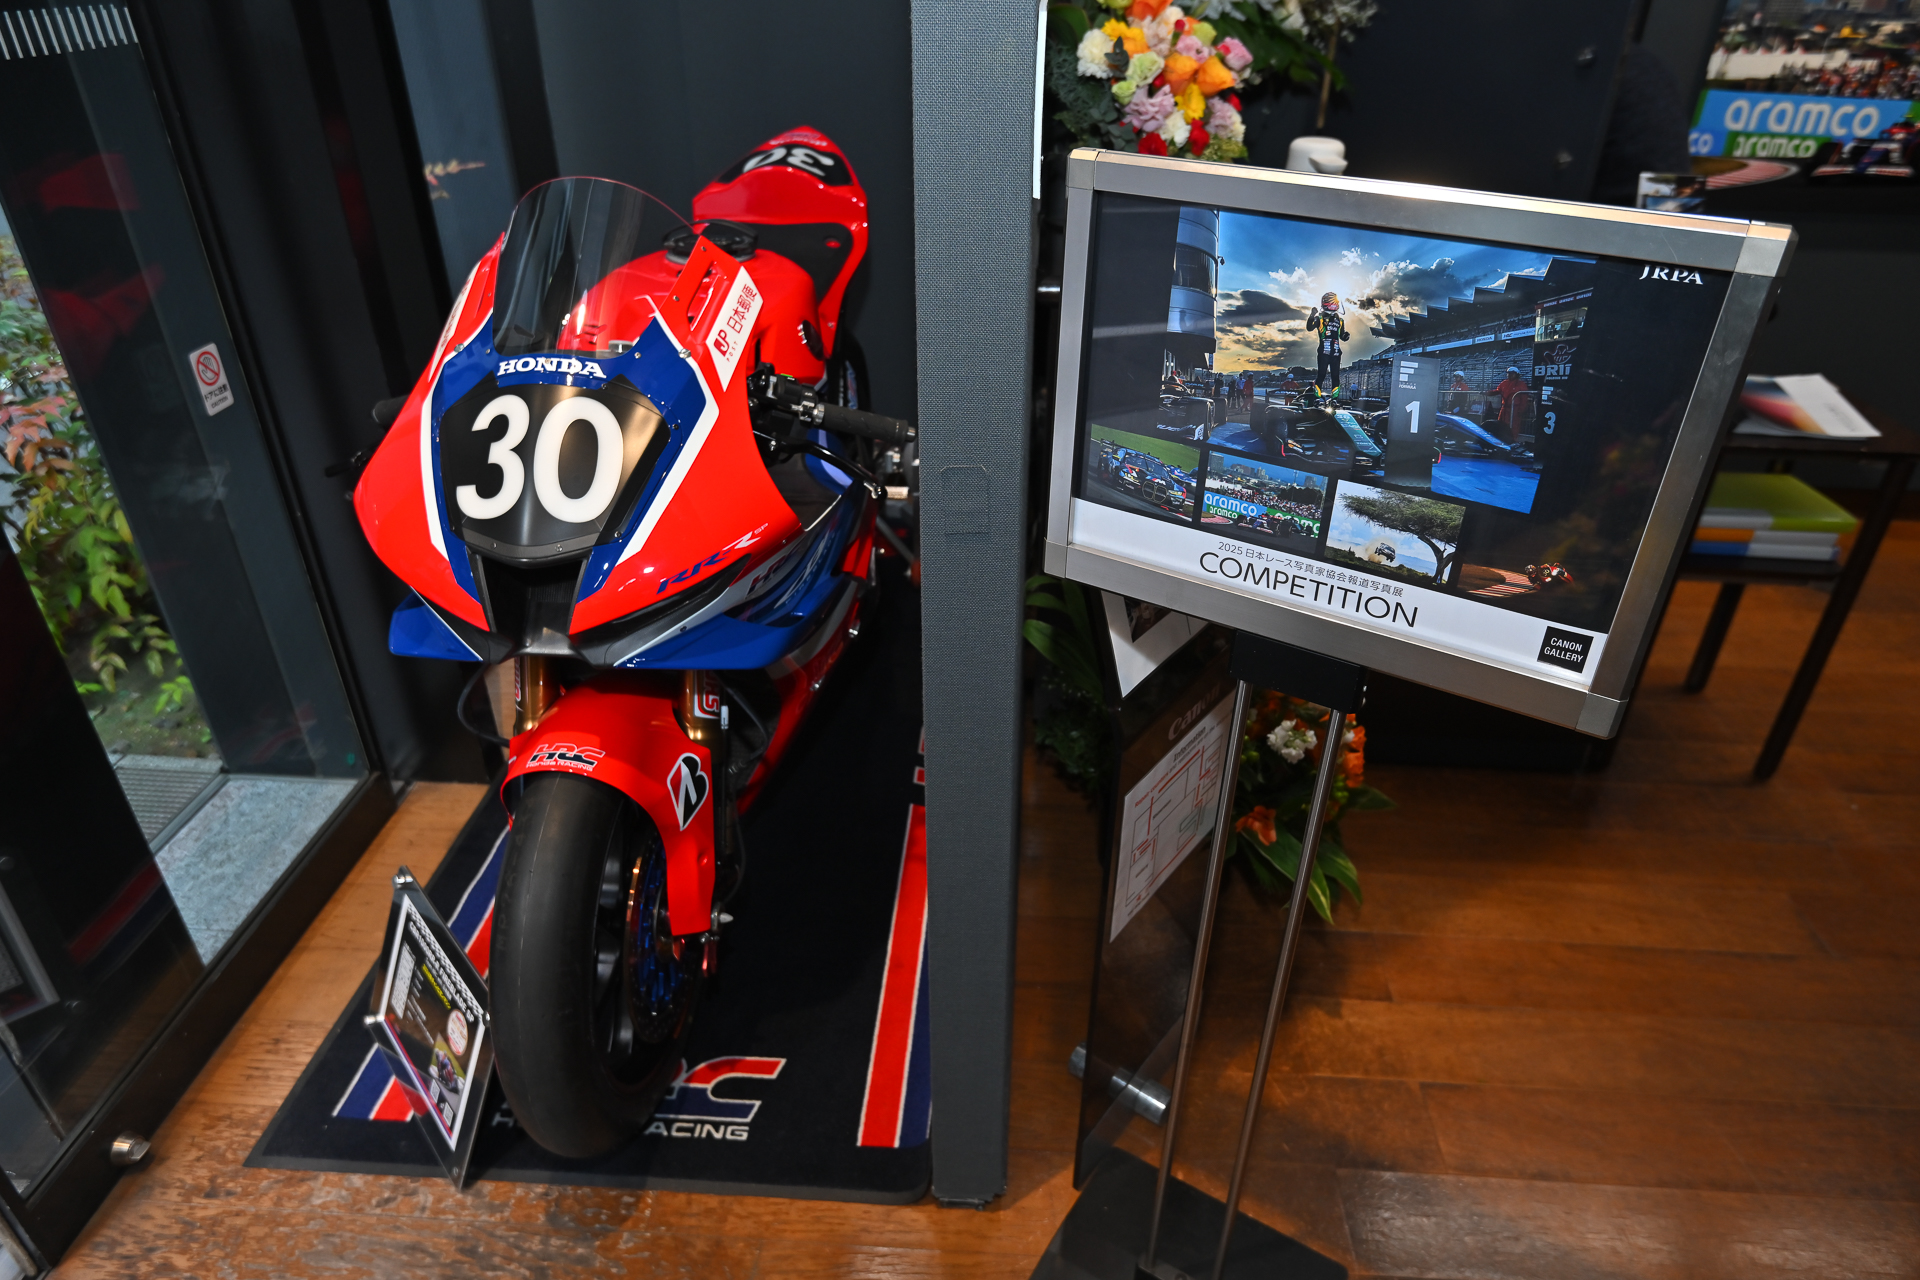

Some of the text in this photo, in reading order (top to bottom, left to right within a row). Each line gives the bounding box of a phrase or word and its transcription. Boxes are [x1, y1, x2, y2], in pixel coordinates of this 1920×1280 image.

[1724, 99, 1880, 138] aramco
[1639, 264, 1704, 286] JRPA
[726, 283, 758, 334] 日本郵便
[726, 340, 739, 363] POST
[497, 357, 607, 379] HONDA
[1405, 400, 1421, 434] 1
[1543, 411, 1557, 435] 3
[456, 394, 624, 523] 30
[1204, 493, 1257, 517] aramco
[1208, 506, 1238, 519] aramco
[1218, 541, 1405, 598] 2025 日本レース写真家協会報道写真展
[1199, 552, 1419, 628] COMPETITION
[1544, 646, 1584, 663] GALLERY
[1550, 637, 1583, 652] CANON
[530, 742, 606, 766] HRC
[557, 761, 594, 772] RACING
[644, 1121, 750, 1141] ACING
